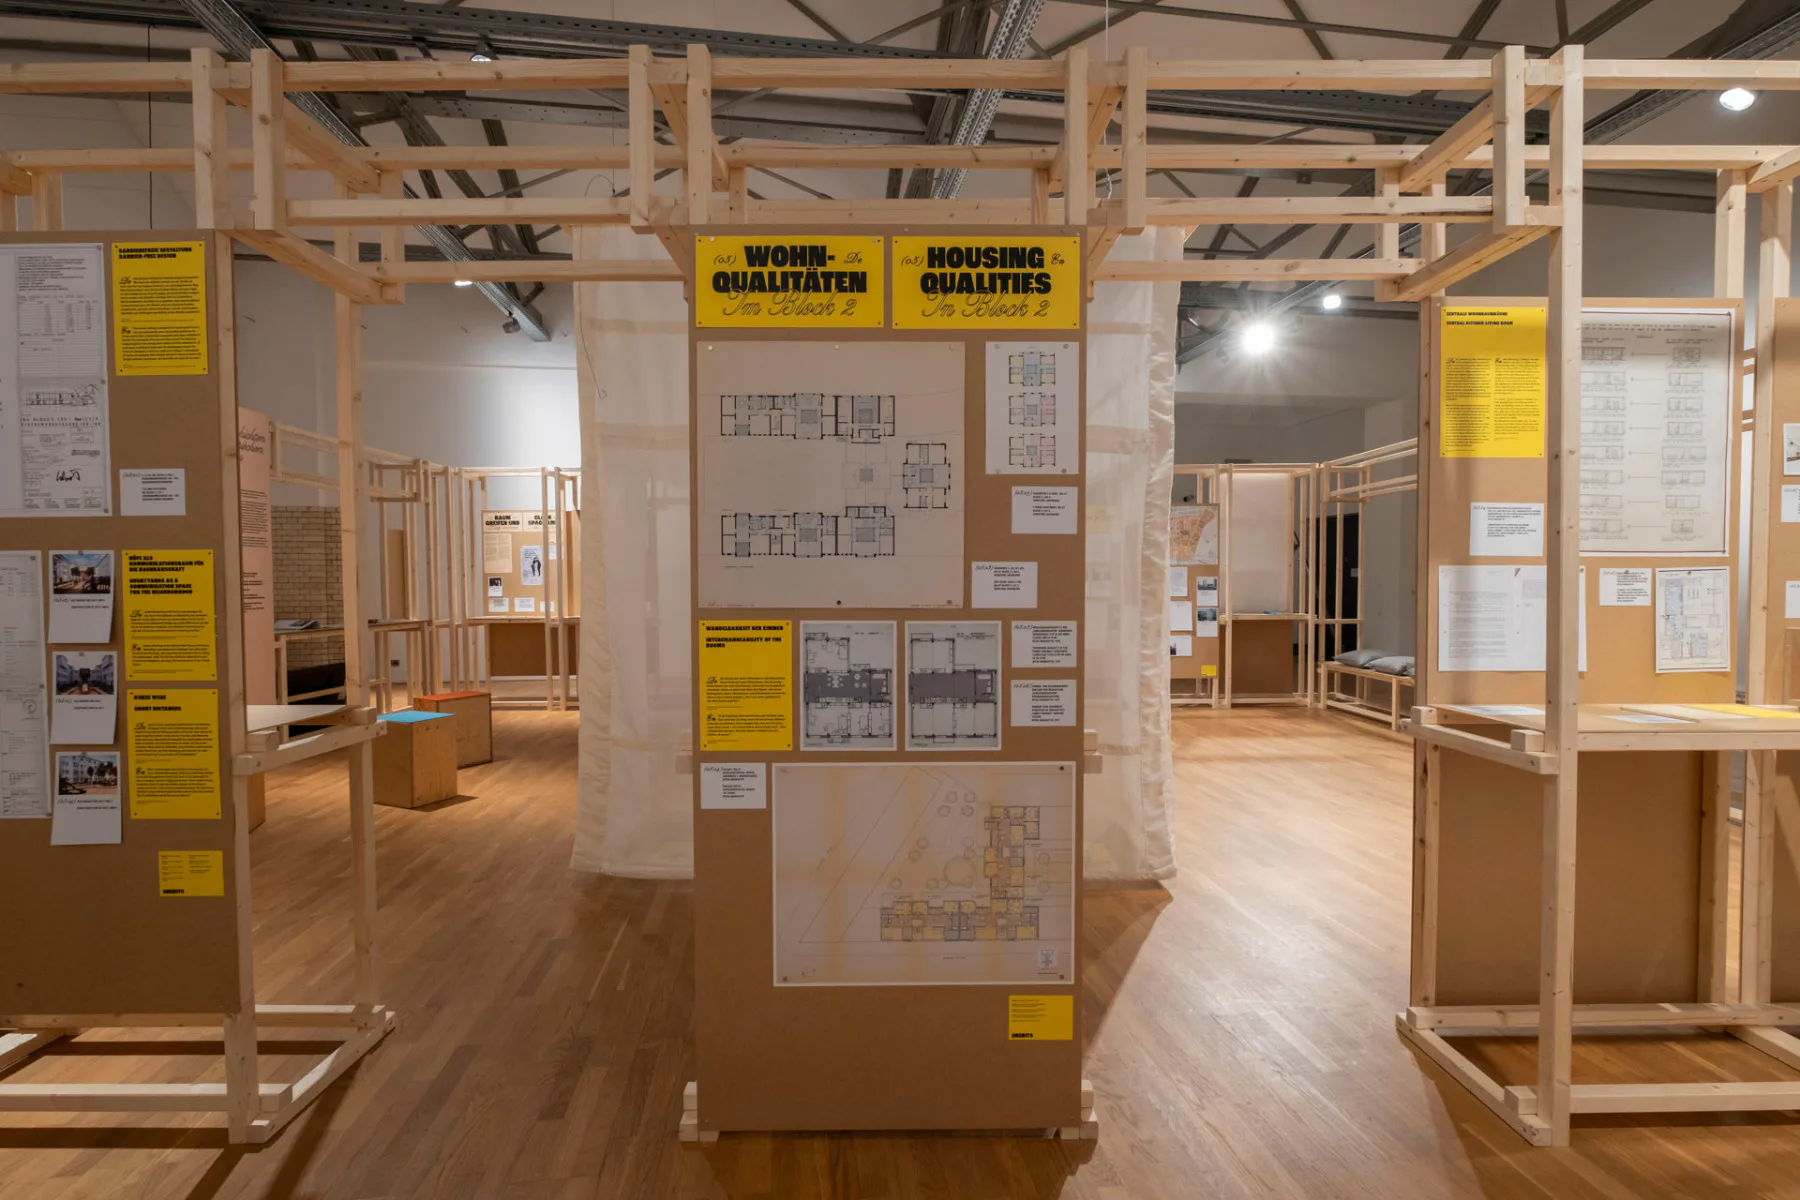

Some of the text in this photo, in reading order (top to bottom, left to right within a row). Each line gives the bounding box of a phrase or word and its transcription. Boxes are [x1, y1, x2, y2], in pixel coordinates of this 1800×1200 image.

[713, 245, 863, 268] (05) WOHN- De
[900, 247, 1065, 269] (05) HOUSING En
[712, 268, 867, 293] QUALITÄTEN
[920, 272, 1052, 294] QUALITIES
[722, 287, 858, 316] Im Block 2
[921, 289, 1051, 317] In Block 2
